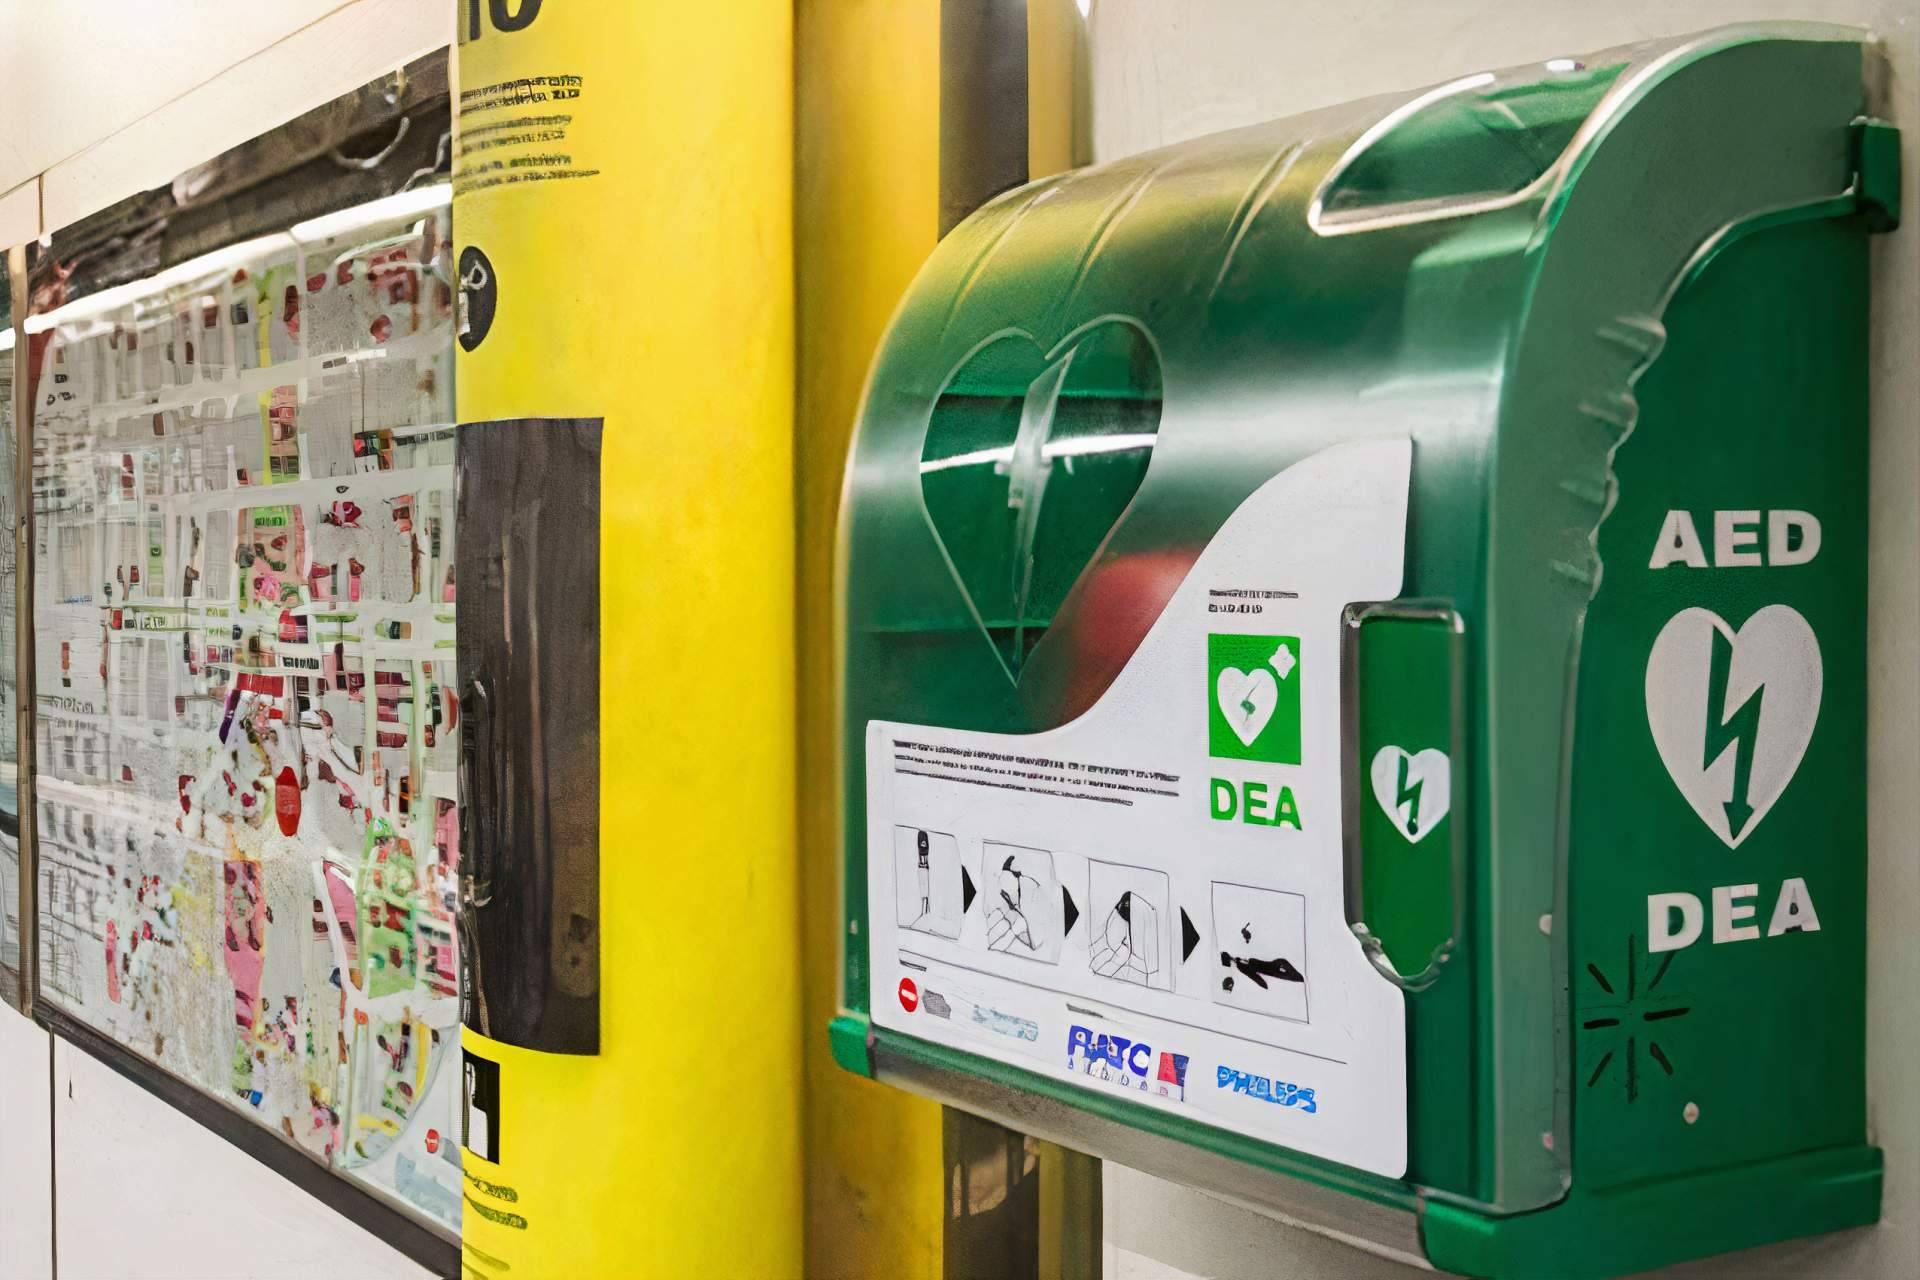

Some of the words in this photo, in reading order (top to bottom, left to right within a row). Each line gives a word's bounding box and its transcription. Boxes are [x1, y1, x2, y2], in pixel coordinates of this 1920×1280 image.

[1648, 509, 1822, 569] AED
[1209, 777, 1302, 831] DEA
[1647, 877, 1821, 953] DEA
